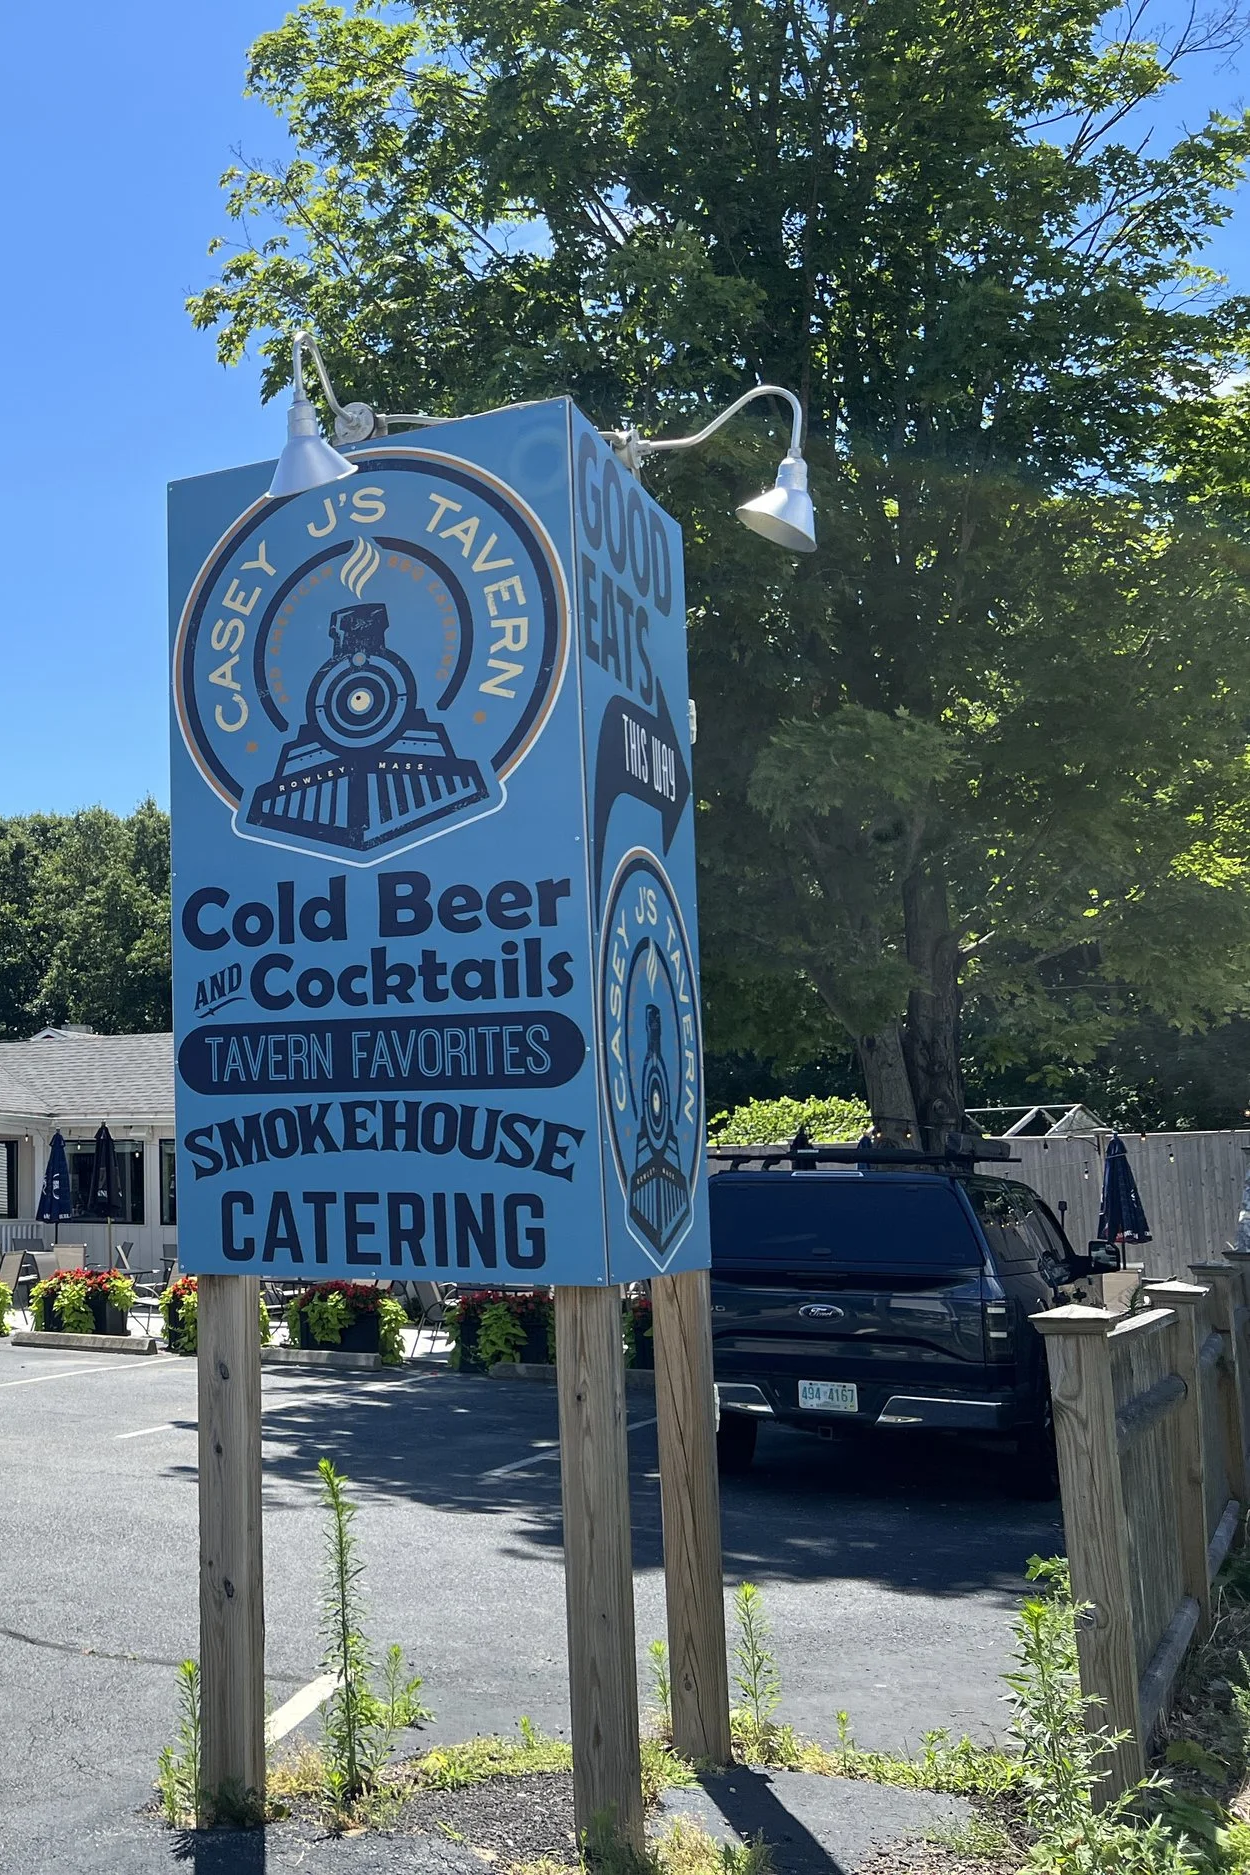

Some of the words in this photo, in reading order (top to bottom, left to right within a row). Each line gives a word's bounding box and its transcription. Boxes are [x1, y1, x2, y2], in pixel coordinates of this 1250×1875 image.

[578, 431, 672, 618] GOOD
[208, 540, 277, 733] CASEY
[307, 486, 387, 538] J'S
[425, 492, 529, 699] TAVERN
[581, 552, 654, 706] EATS
[622, 713, 649, 785] THIS
[651, 735, 677, 802] WAY
[181, 874, 347, 951] Cold
[377, 871, 571, 938] Beer
[193, 962, 242, 1011] AND
[250, 937, 574, 1011] Cocktails
[205, 1033, 333, 1082] TAVERN
[351, 1024, 551, 1079] FAVORITES
[610, 908, 630, 1112] CASEY
[666, 915, 695, 1125] TAVERN
[184, 1099, 586, 1182] SMOKEHOUSE
[220, 1190, 546, 1270] CATERING
[802, 1386, 821, 1400] 494
[828, 1387, 854, 1402] 4167
